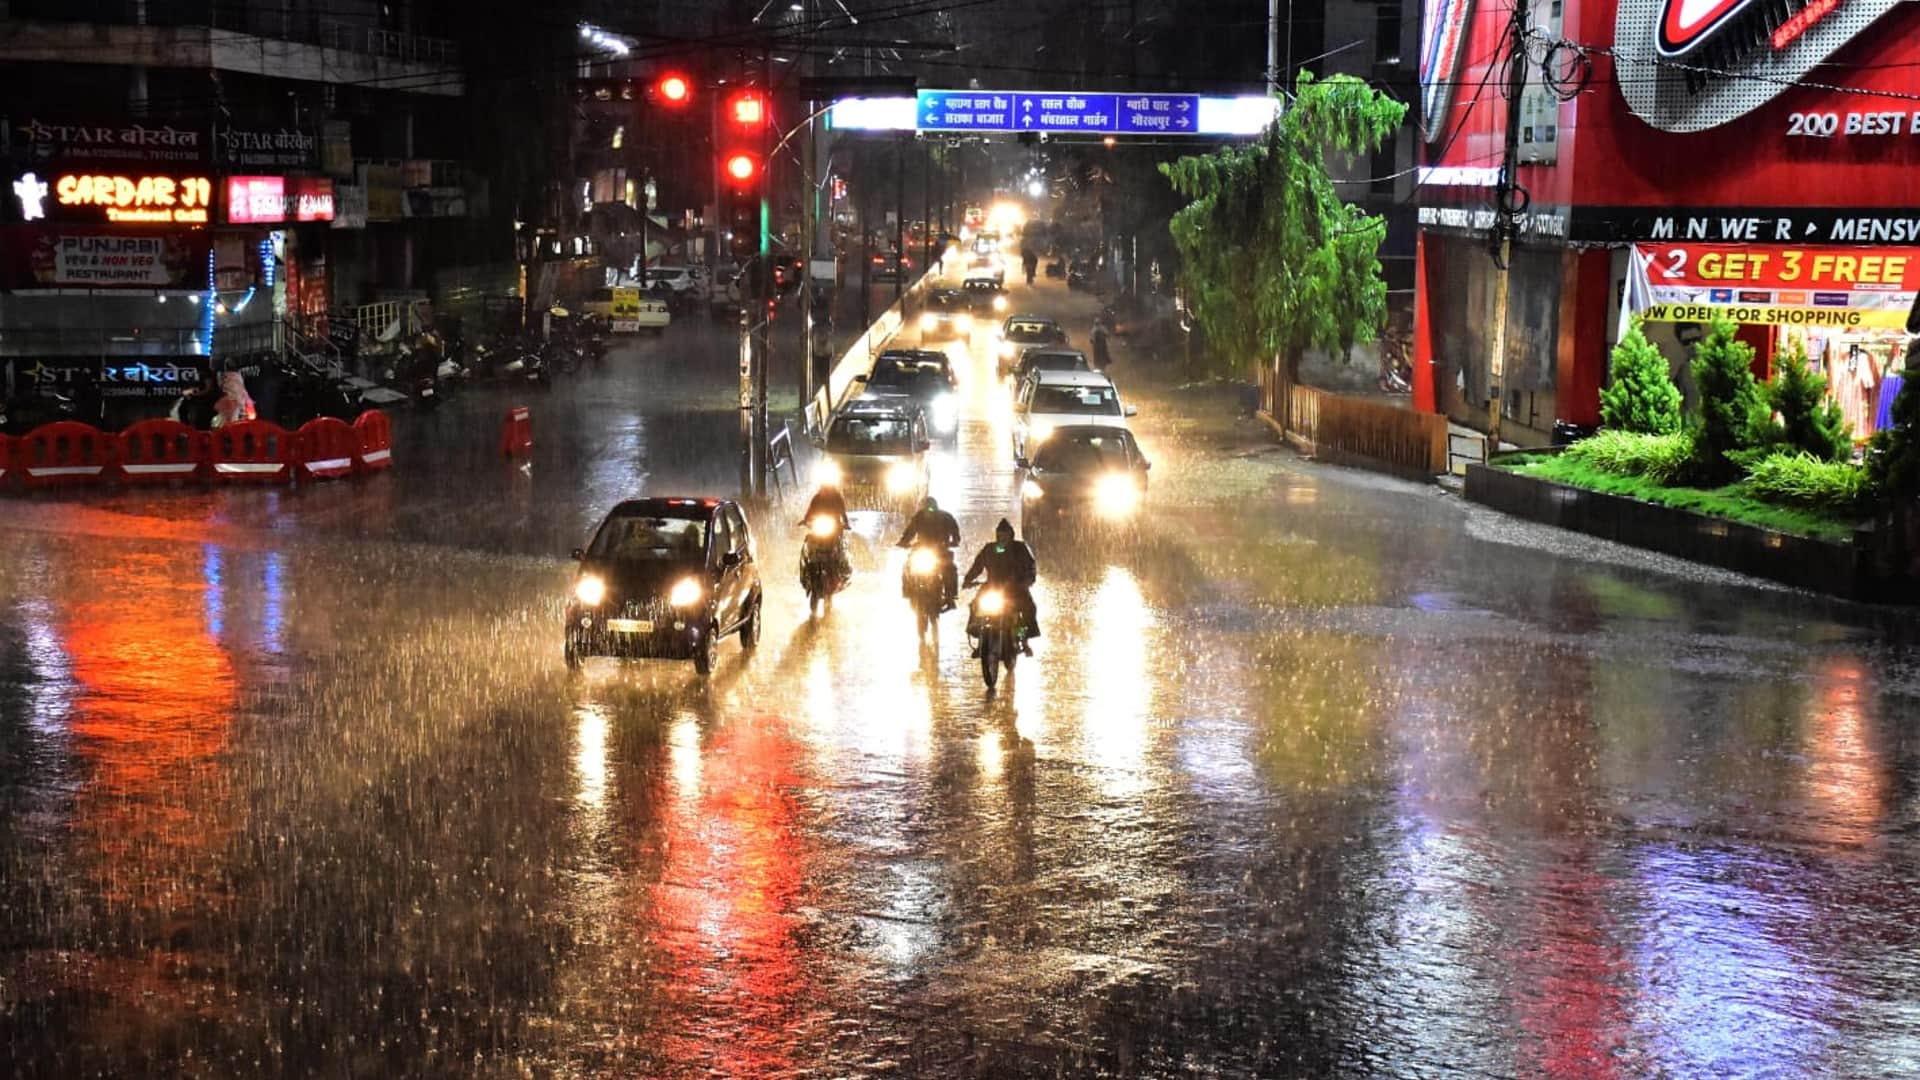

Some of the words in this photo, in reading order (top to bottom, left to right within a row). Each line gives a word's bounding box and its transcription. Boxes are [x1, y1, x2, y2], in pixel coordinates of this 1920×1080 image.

[1786, 112, 1839, 136] 200
[1844, 111, 1907, 135] BEST
[36, 125, 115, 143] STAR
[230, 131, 273, 150] STAR
[57, 175, 176, 207] SARDAR
[1718, 216, 1793, 241] WER
[62, 238, 159, 254] PUNJABI
[64, 255, 89, 265] VEG
[101, 255, 128, 265] NON
[131, 256, 154, 266] VEG
[1662, 248, 1688, 279] 2
[1696, 252, 1770, 280] GET
[1779, 250, 1804, 282] 3
[1811, 255, 1907, 284] FREE
[66, 269, 152, 280] RESTAURANT
[1727, 307, 1761, 322] FOR
[1767, 310, 1861, 325] SHOPPING
